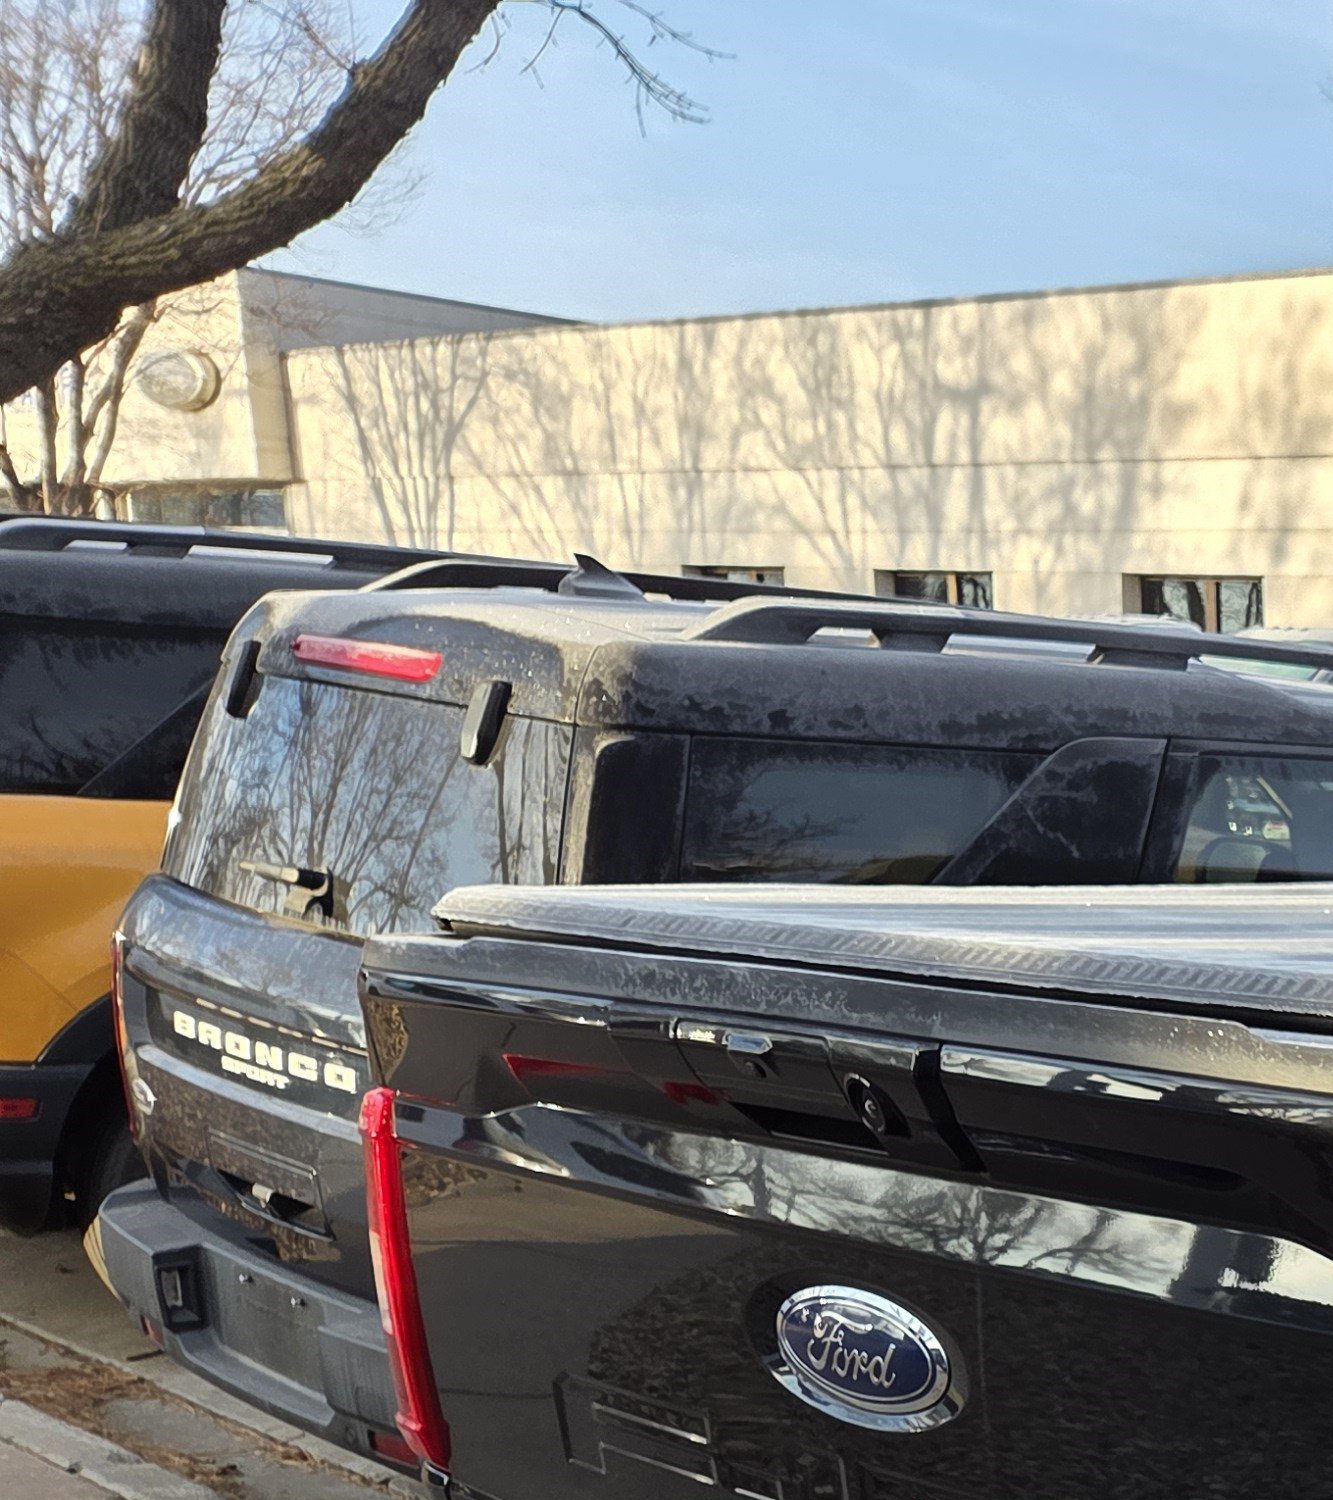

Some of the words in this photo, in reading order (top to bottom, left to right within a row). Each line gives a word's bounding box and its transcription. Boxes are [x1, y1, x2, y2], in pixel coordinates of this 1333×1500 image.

[173, 1010, 358, 1094] BRONCO
[221, 1055, 290, 1090] SPORT
[806, 1309, 897, 1388] Ford
